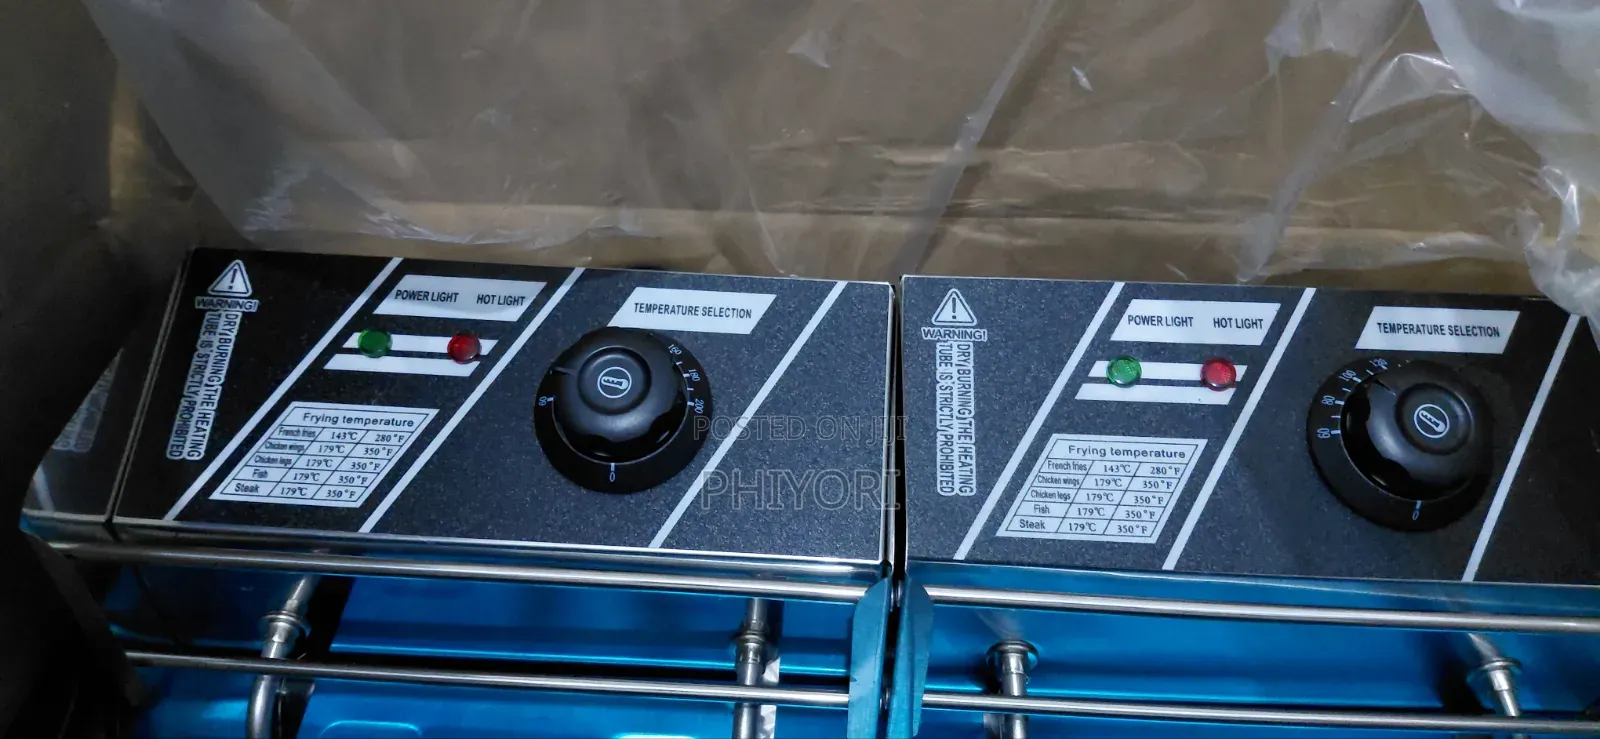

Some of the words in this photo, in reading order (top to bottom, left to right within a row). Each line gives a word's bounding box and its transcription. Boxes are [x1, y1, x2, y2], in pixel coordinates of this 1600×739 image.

[394, 289, 430, 301] POWER
[431, 291, 460, 303] LIGHT
[476, 293, 496, 304] HOT
[498, 295, 526, 307] LIGHT
[195, 299, 257, 311] WARNING!
[633, 302, 700, 317] TEMPERATURE
[701, 305, 753, 319] SELECTION
[201, 312, 222, 337] TUBE
[1127, 314, 1164, 327] POWER
[1165, 316, 1194, 328] LIGHT
[1213, 317, 1233, 329] HOT
[1235, 318, 1264, 330] LIGHT
[922, 328, 987, 341] WARNING!
[1376, 322, 1446, 336] TEMPERATURE
[1447, 324, 1501, 338] SELECTION
[938, 343, 953, 368] TUBE
[186, 351, 212, 399] STRICTLY
[688, 368, 701, 382] 180
[1339, 369, 1357, 382] 100
[200, 384, 218, 409] THE
[1321, 395, 1336, 406] 80
[694, 398, 705, 414] 200
[938, 385, 954, 430] STRICTLY
[302, 412, 339, 426] Frying
[342, 413, 415, 428] temperature
[168, 400, 197, 458] PROHIBITED
[187, 411, 212, 458] HEATING
[278, 426, 301, 437] French
[302, 427, 317, 438] fries
[957, 420, 973, 443] THE
[1316, 427, 1331, 439] 60
[1068, 444, 1107, 458] Frying
[1110, 446, 1186, 459] temperature
[254, 454, 279, 465] Chicken
[939, 433, 955, 494] PROHIBITED
[1047, 460, 1071, 471] French
[1072, 461, 1088, 472] fries
[252, 468, 269, 479] Fish
[958, 446, 974, 494] HEATING
[1037, 474, 1062, 485] Chicken
[1062, 476, 1080, 487] wings
[234, 482, 260, 494] Steak
[1030, 488, 1057, 499] Chicken
[1057, 490, 1071, 501] legs
[1033, 504, 1050, 514] Fish
[1019, 519, 1046, 530] Steak
